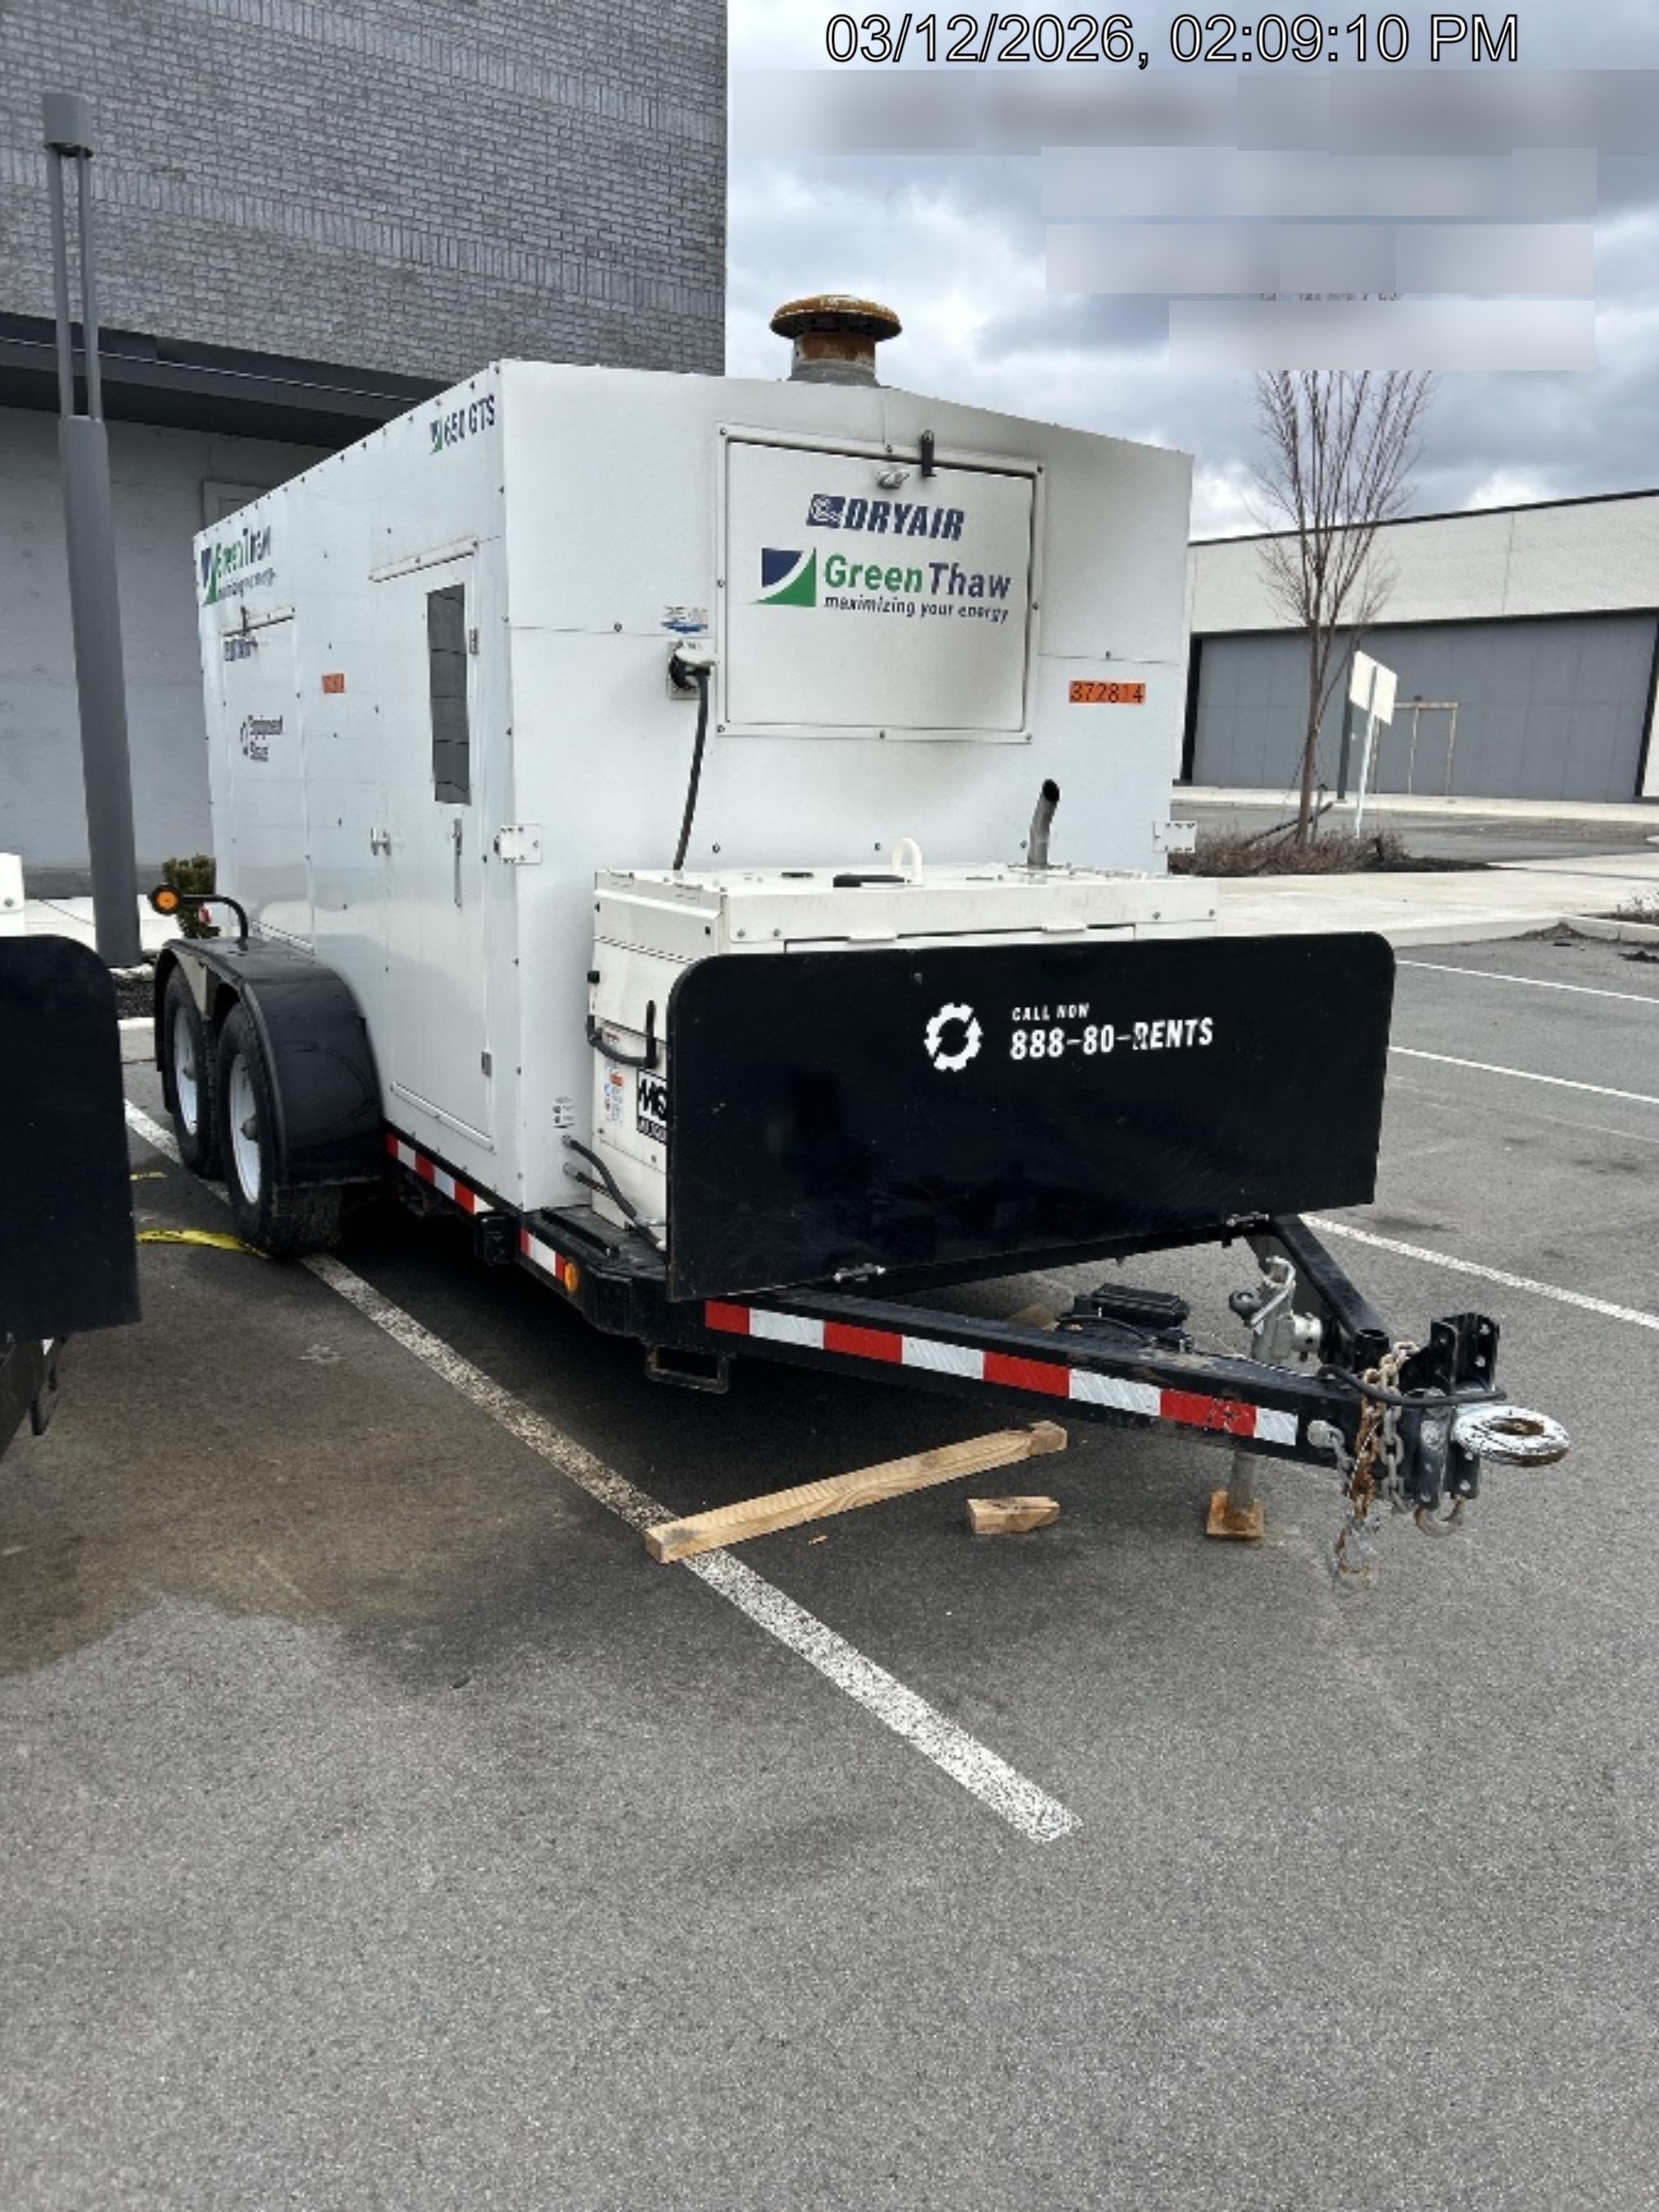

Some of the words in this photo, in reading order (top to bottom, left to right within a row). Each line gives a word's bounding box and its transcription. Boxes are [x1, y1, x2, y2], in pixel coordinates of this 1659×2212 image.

[469, 394, 494, 435] GTS
[843, 498, 965, 541] DRYAIR
[824, 596, 915, 618] maximizing
[920, 602, 953, 619] your
[959, 604, 1009, 623] energy
[1070, 682, 1144, 703] 372814
[1012, 1005, 1050, 1022] CALL
[1057, 1003, 1090, 1019] NOW
[1010, 1018, 1214, 1060] 888-80-RENTS
